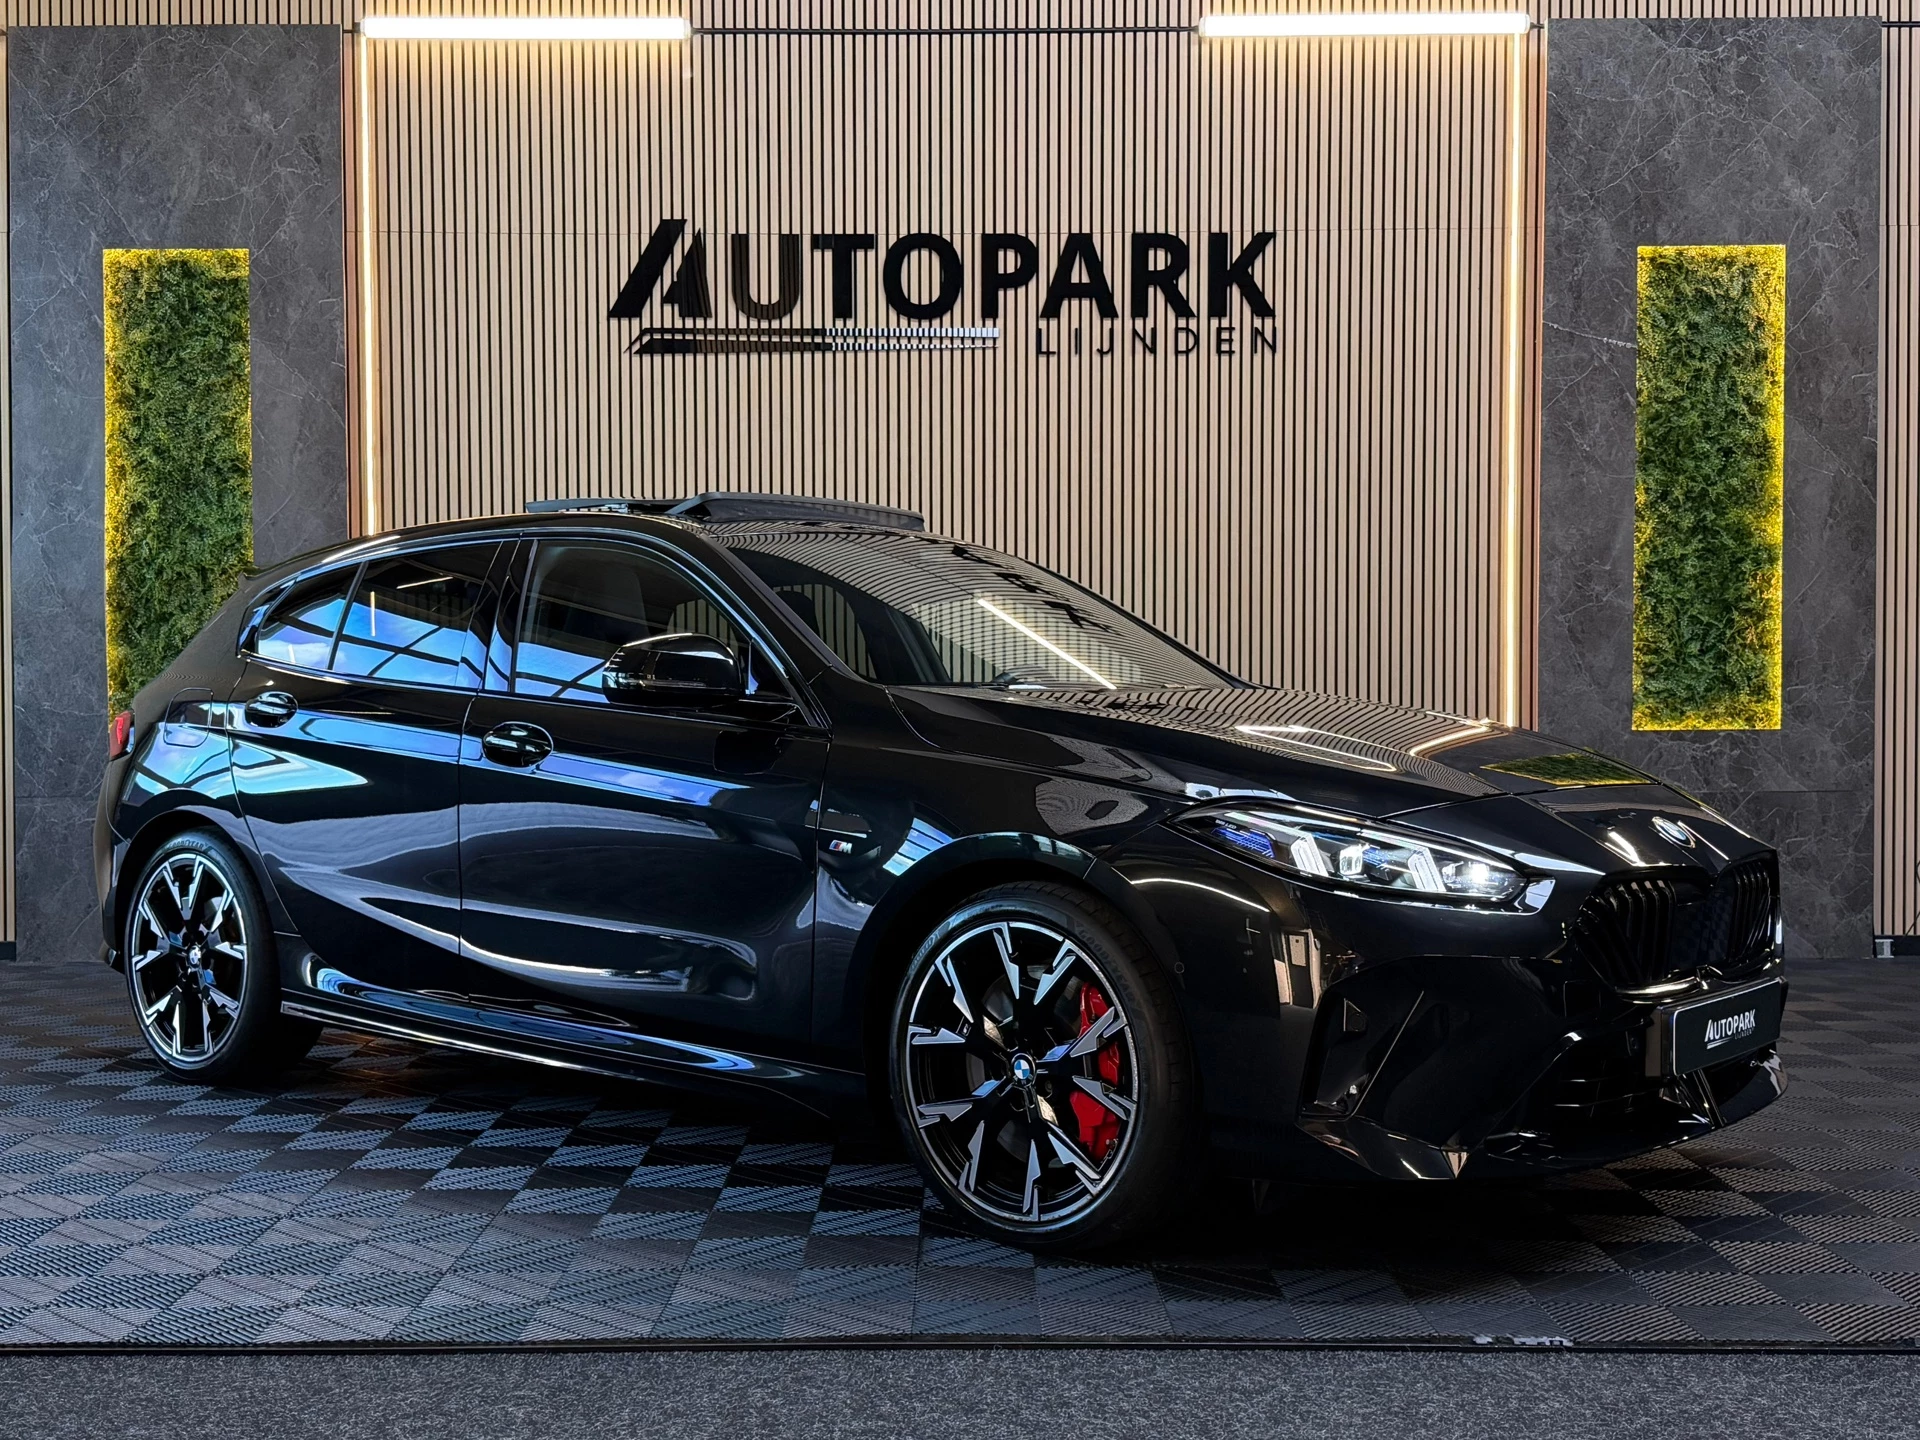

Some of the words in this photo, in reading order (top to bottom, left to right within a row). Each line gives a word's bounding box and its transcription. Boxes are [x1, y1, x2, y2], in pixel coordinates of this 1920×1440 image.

[608, 218, 1276, 320] AUTOPARK
[1037, 326, 1277, 355] LIJNDEN
[1704, 1008, 1756, 1043] AUTOPARK
